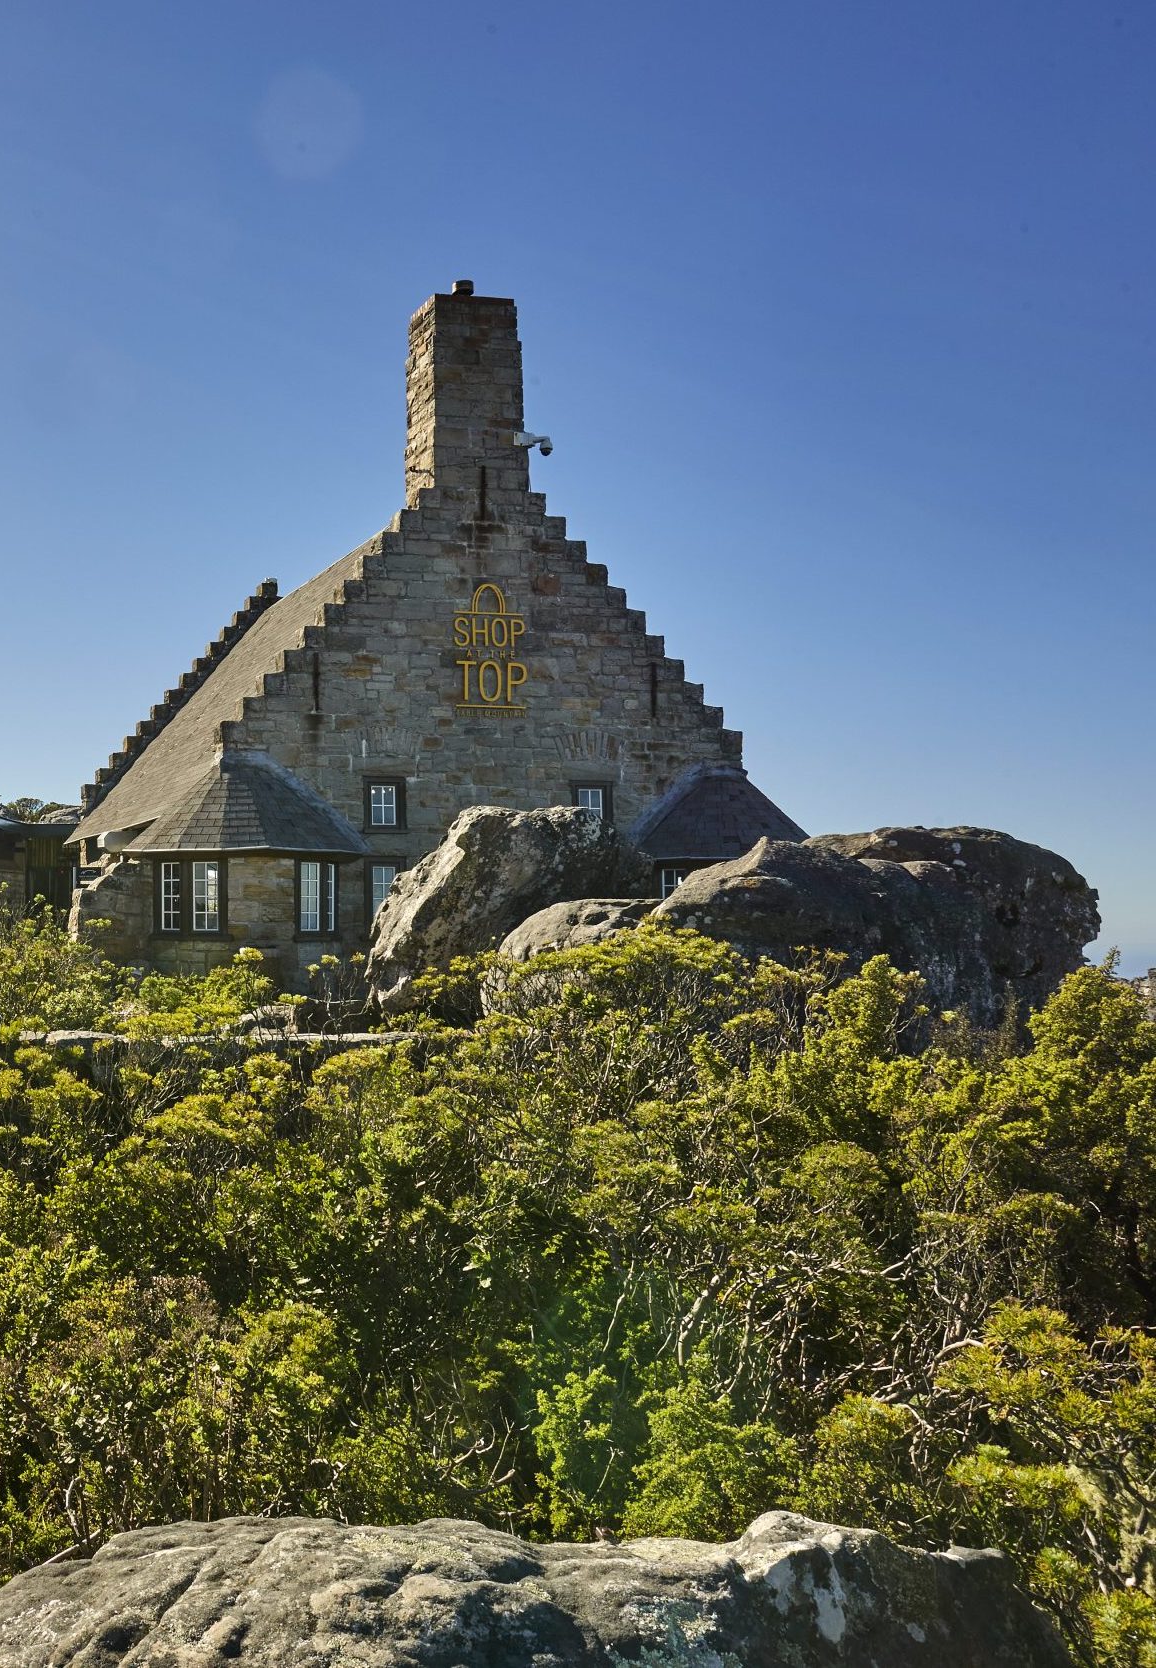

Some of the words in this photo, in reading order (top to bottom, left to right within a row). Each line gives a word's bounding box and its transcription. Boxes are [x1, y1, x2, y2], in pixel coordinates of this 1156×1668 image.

[454, 616, 525, 647] SHOP
[466, 649, 482, 658] AT
[490, 649, 516, 660] THE
[456, 660, 528, 702] TOP
